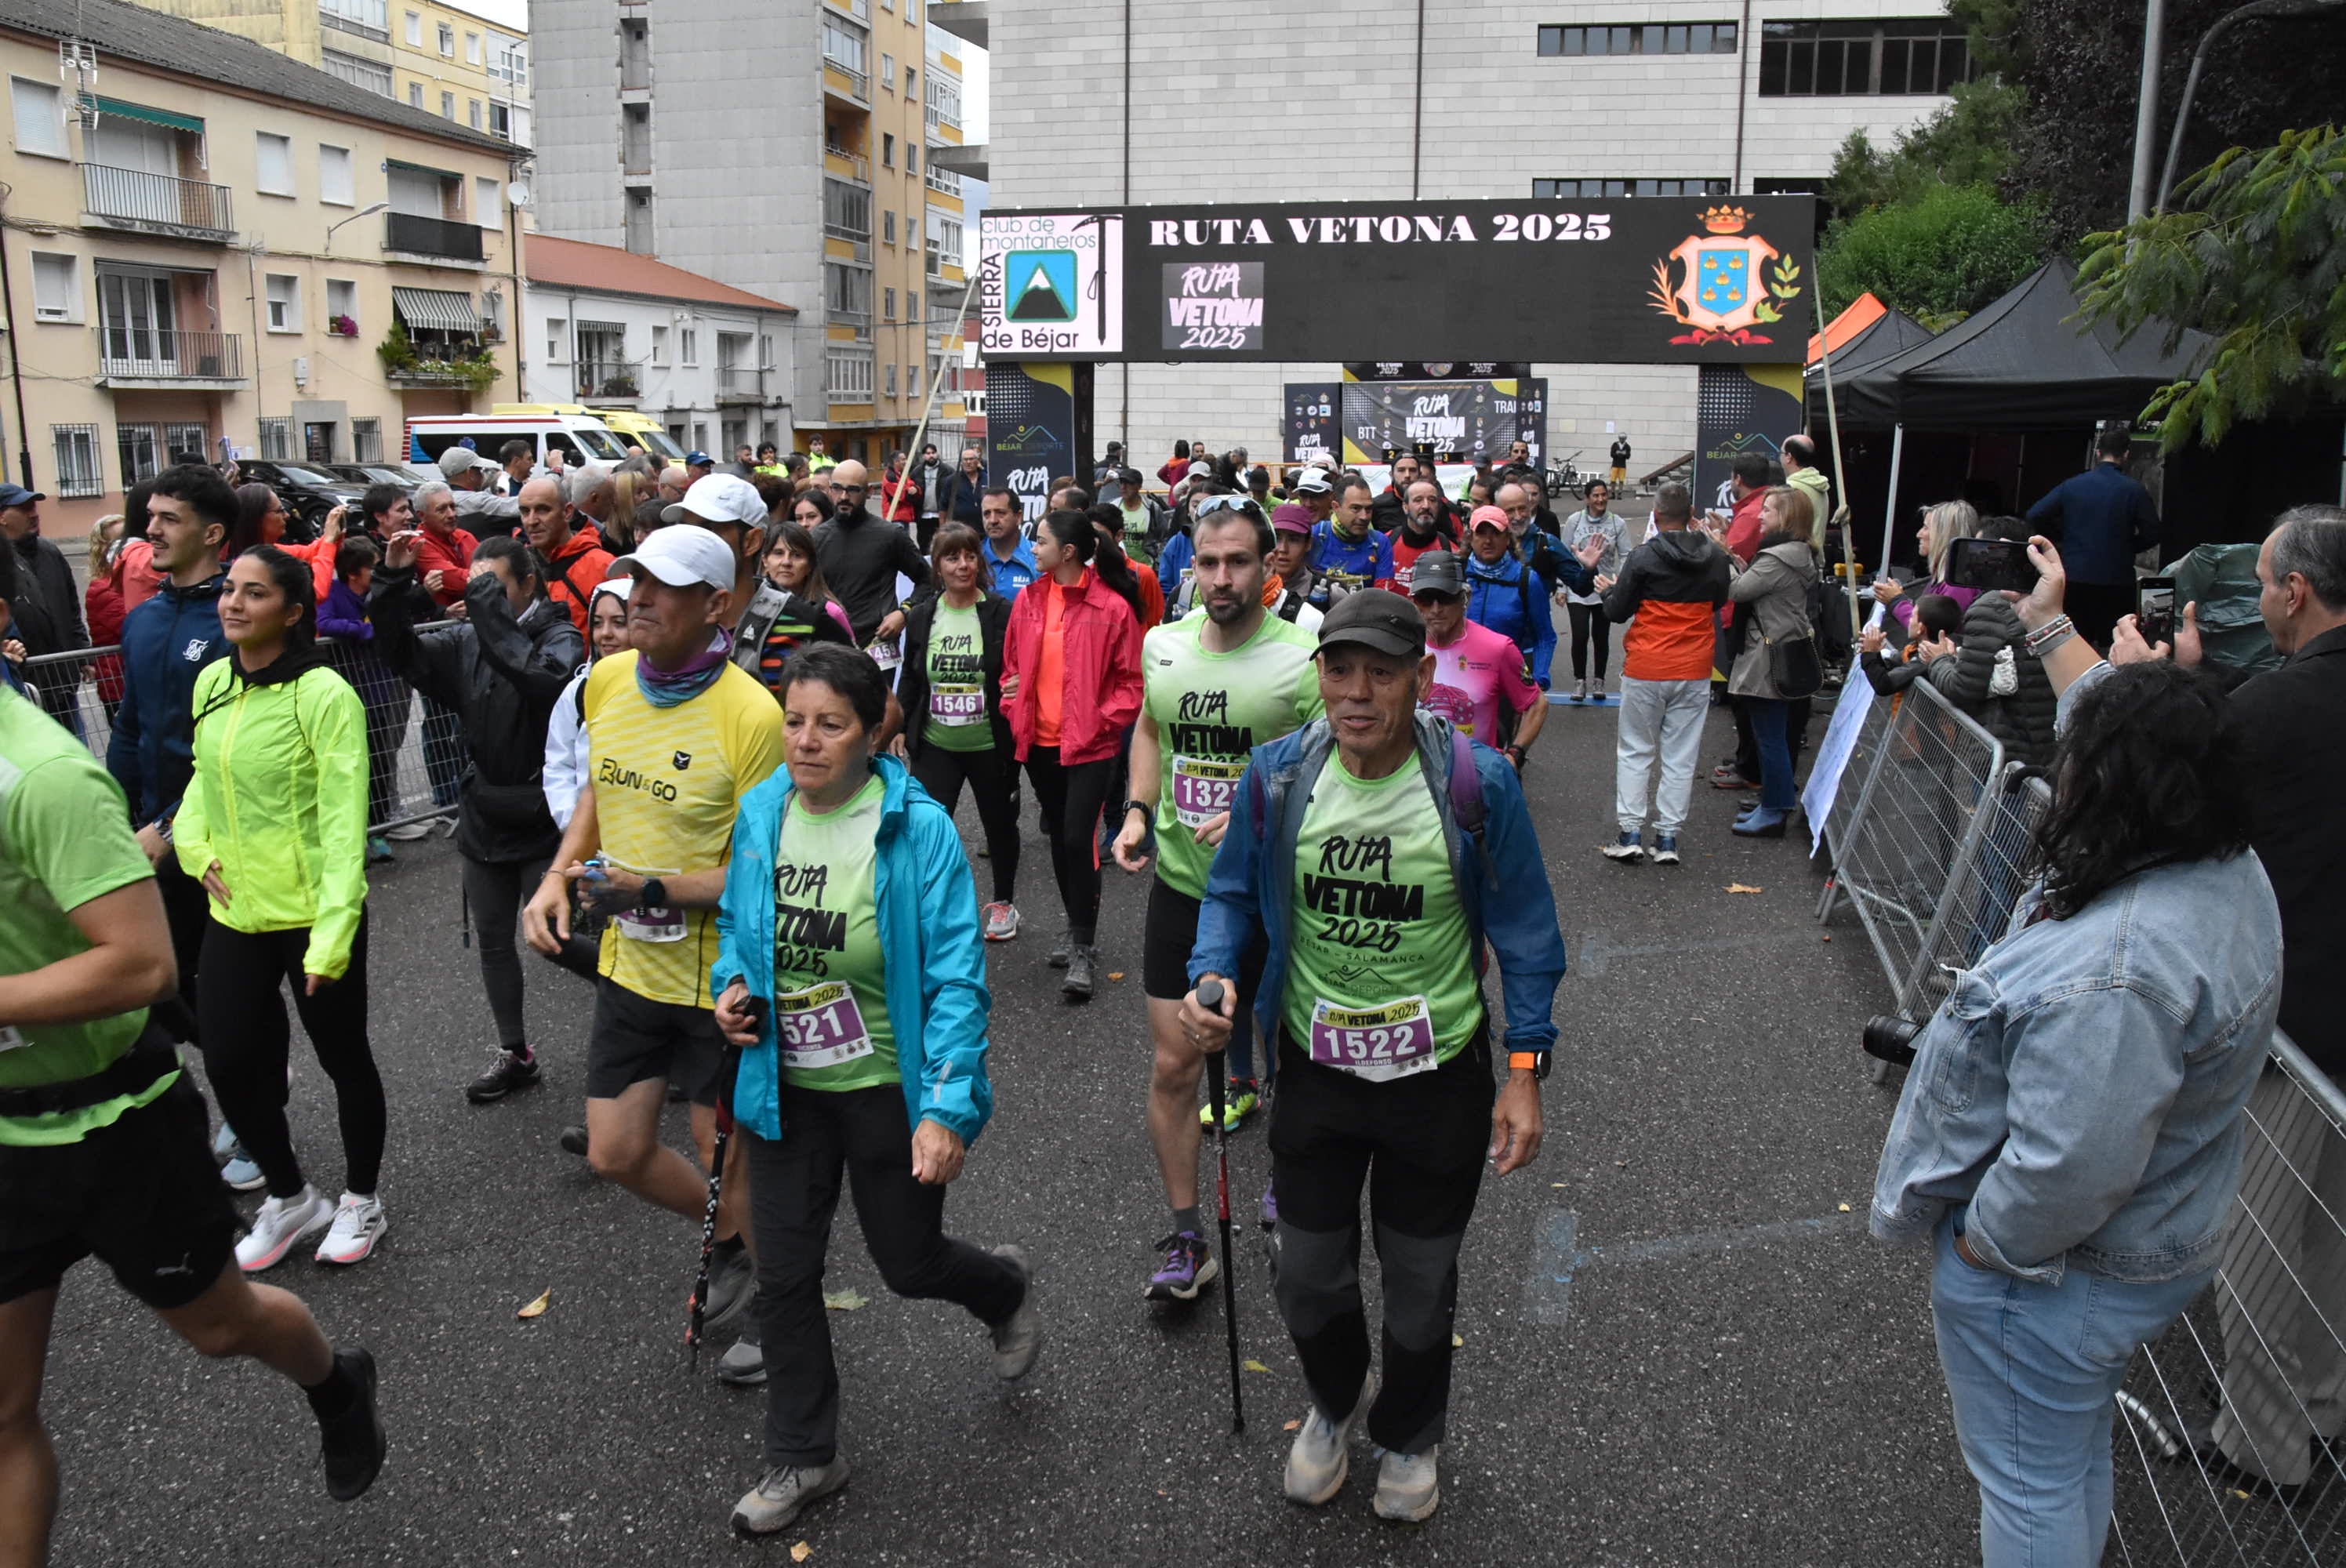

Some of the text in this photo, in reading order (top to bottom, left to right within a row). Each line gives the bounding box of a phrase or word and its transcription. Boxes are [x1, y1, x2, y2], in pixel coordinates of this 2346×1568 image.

[982, 216, 1055, 234] club de
[1149, 213, 1612, 245] RUTA VETONA 2025
[982, 232, 1096, 250] montañeros
[982, 252, 1002, 327] SIERRA
[1180, 263, 1240, 298] RUTA
[1168, 297, 1264, 328] VETONA
[982, 328, 1079, 352] de Béjar
[1179, 325, 1247, 350] 2025
[1413, 394, 1450, 417] RUTA
[1494, 400, 1516, 414] TRAI
[1357, 426, 1377, 440] BTT
[1405, 416, 1465, 438] VETONA
[1007, 466, 1050, 495] RUTA
[873, 643, 896, 661] 459
[941, 633, 972, 654] RUTA
[940, 672, 977, 684] 2025
[935, 695, 977, 713] 1546
[1178, 689, 1228, 724] RUTA
[1168, 722, 1253, 757] VETONA
[1231, 768, 1245, 778] 20
[1182, 777, 1238, 808] 132
[1319, 835, 1393, 883] RUTA
[774, 862, 827, 908] RUTA
[1303, 873, 1425, 922] VETONA
[775, 902, 847, 952] TONA
[1318, 916, 1402, 953] 2025
[775, 944, 828, 977] 025
[1346, 952, 1425, 964] SALAMANCA
[778, 985, 844, 1011] ETONA 2025
[779, 1005, 844, 1045] 521
[1346, 1011, 1386, 1026] VETONA
[1389, 1001, 1421, 1022] 2025
[1324, 1025, 1417, 1060] 1522
[1354, 1058, 1393, 1067] ILDEFONSO
